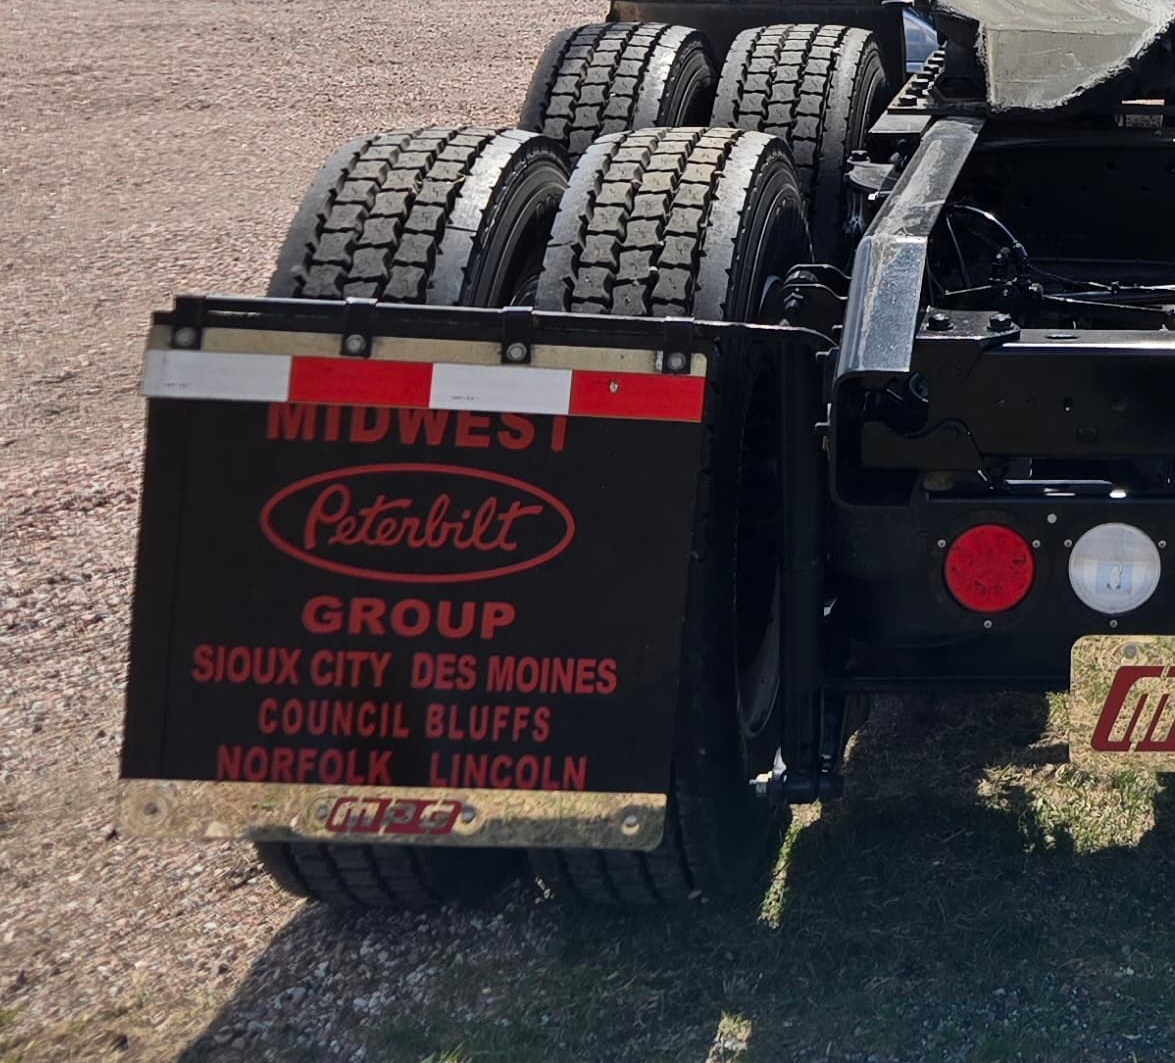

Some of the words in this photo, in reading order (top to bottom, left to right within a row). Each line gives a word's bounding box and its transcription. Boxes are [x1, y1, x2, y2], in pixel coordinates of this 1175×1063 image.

[267, 402, 568, 451] MIDWEST
[303, 484, 544, 550] Peterbilt
[302, 595, 516, 640] GROUP
[192, 644, 302, 685] SIOUX
[311, 649, 393, 688] CITY
[412, 651, 477, 691] DES
[487, 655, 618, 695] MOINES
[258, 697, 410, 738] COUNCIL
[426, 703, 551, 742] BLUFFS
[217, 744, 393, 784] NORFOLK
[429, 754, 588, 791] LINCOLN
